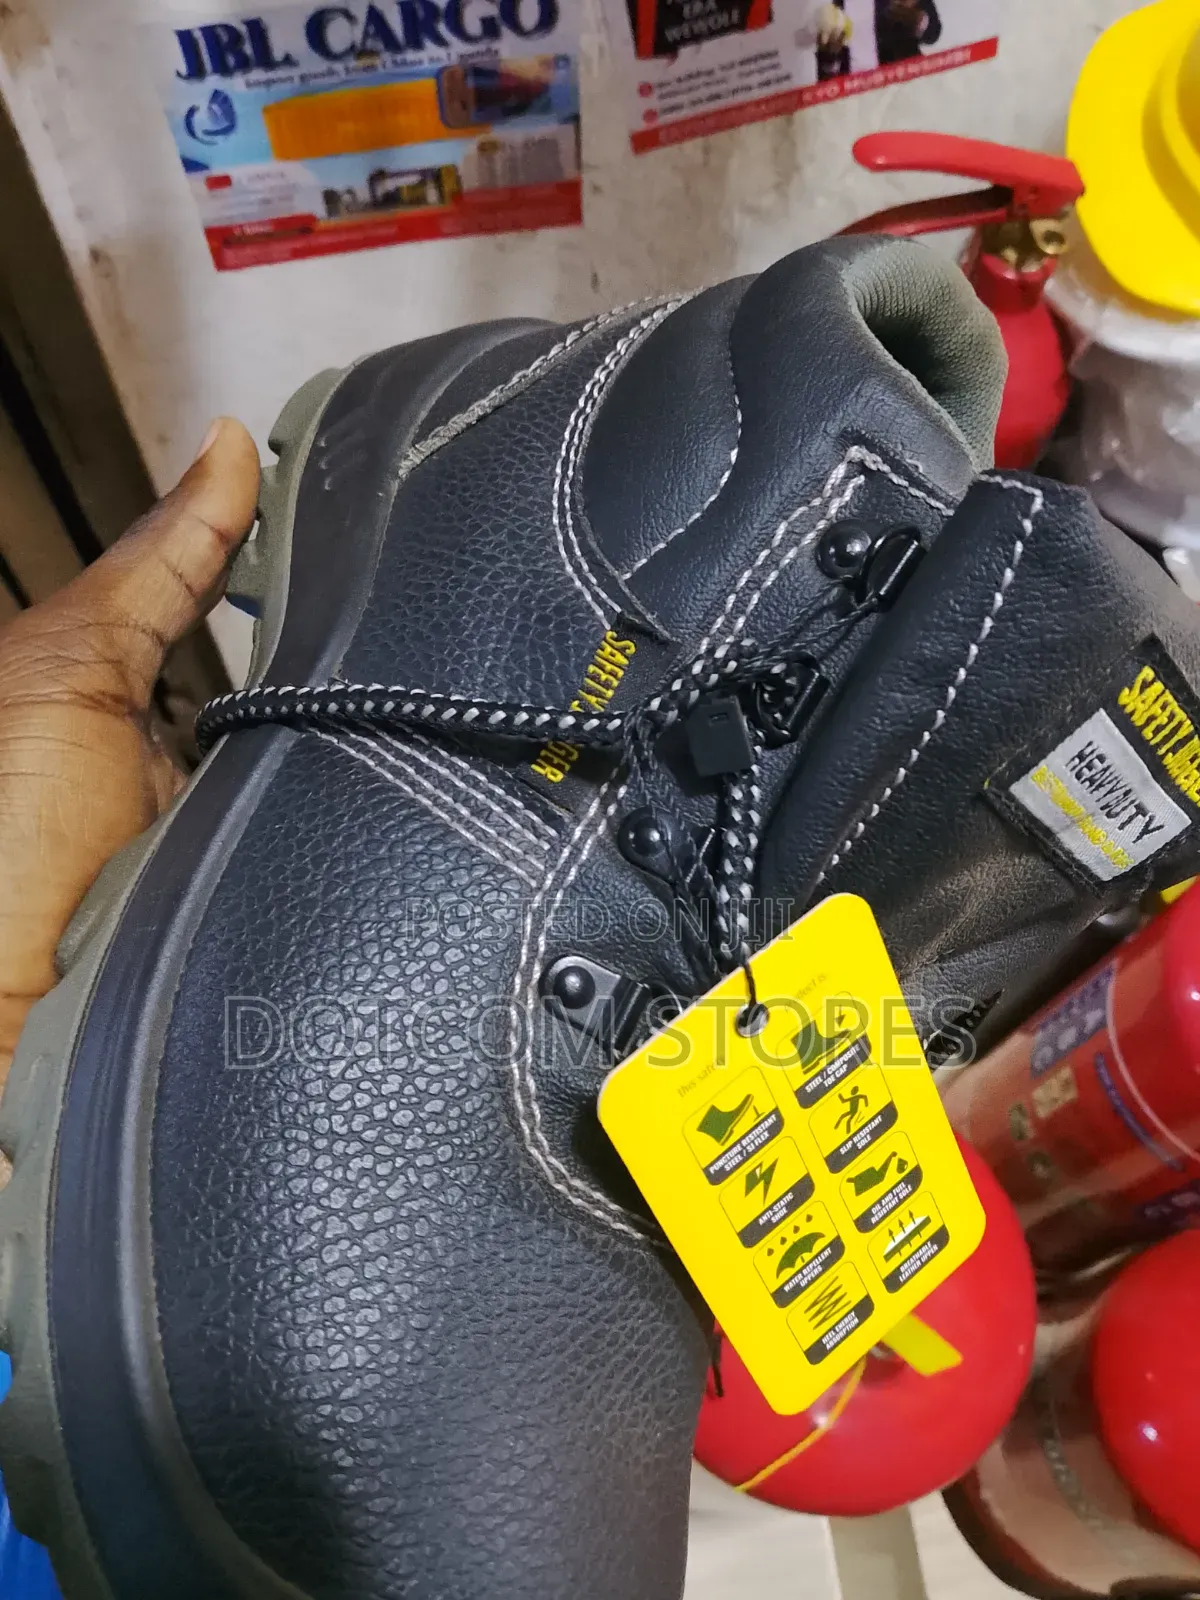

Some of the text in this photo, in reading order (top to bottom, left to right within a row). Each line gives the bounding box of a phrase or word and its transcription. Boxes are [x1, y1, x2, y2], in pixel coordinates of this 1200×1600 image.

[175, 0, 559, 81] JBL CARGO
[578, 630, 637, 711] SAFETY
[1118, 665, 1194, 755] SAFETY
[805, 1077, 824, 1093] STEEL
[827, 1043, 861, 1075] COMPOSITE
[823, 1064, 849, 1088] TOE CAP
[724, 1152, 744, 1172] STEEL
[755, 1130, 771, 1147] FLEX
[839, 1114, 883, 1155] SLIP RESISTANT
[856, 1134, 872, 1150] SOLE
[709, 1143, 743, 1175] PUNCTURE
[758, 1191, 795, 1226] ANTI-STATIC
[770, 1206, 789, 1224] SHOE
[871, 1181, 907, 1215] OIL AND FUEL
[871, 1184, 913, 1225] RESISTANT SOLE
[783, 1246, 833, 1293] WATER REPELLENT
[898, 1243, 940, 1283] LEATHER UPPER
[900, 1240, 933, 1273] BREATHABLE
[799, 1264, 823, 1288] UPPERS
[821, 1310, 857, 1345] HEEL ENERGY
[825, 1317, 860, 1351] ABSORPTION
